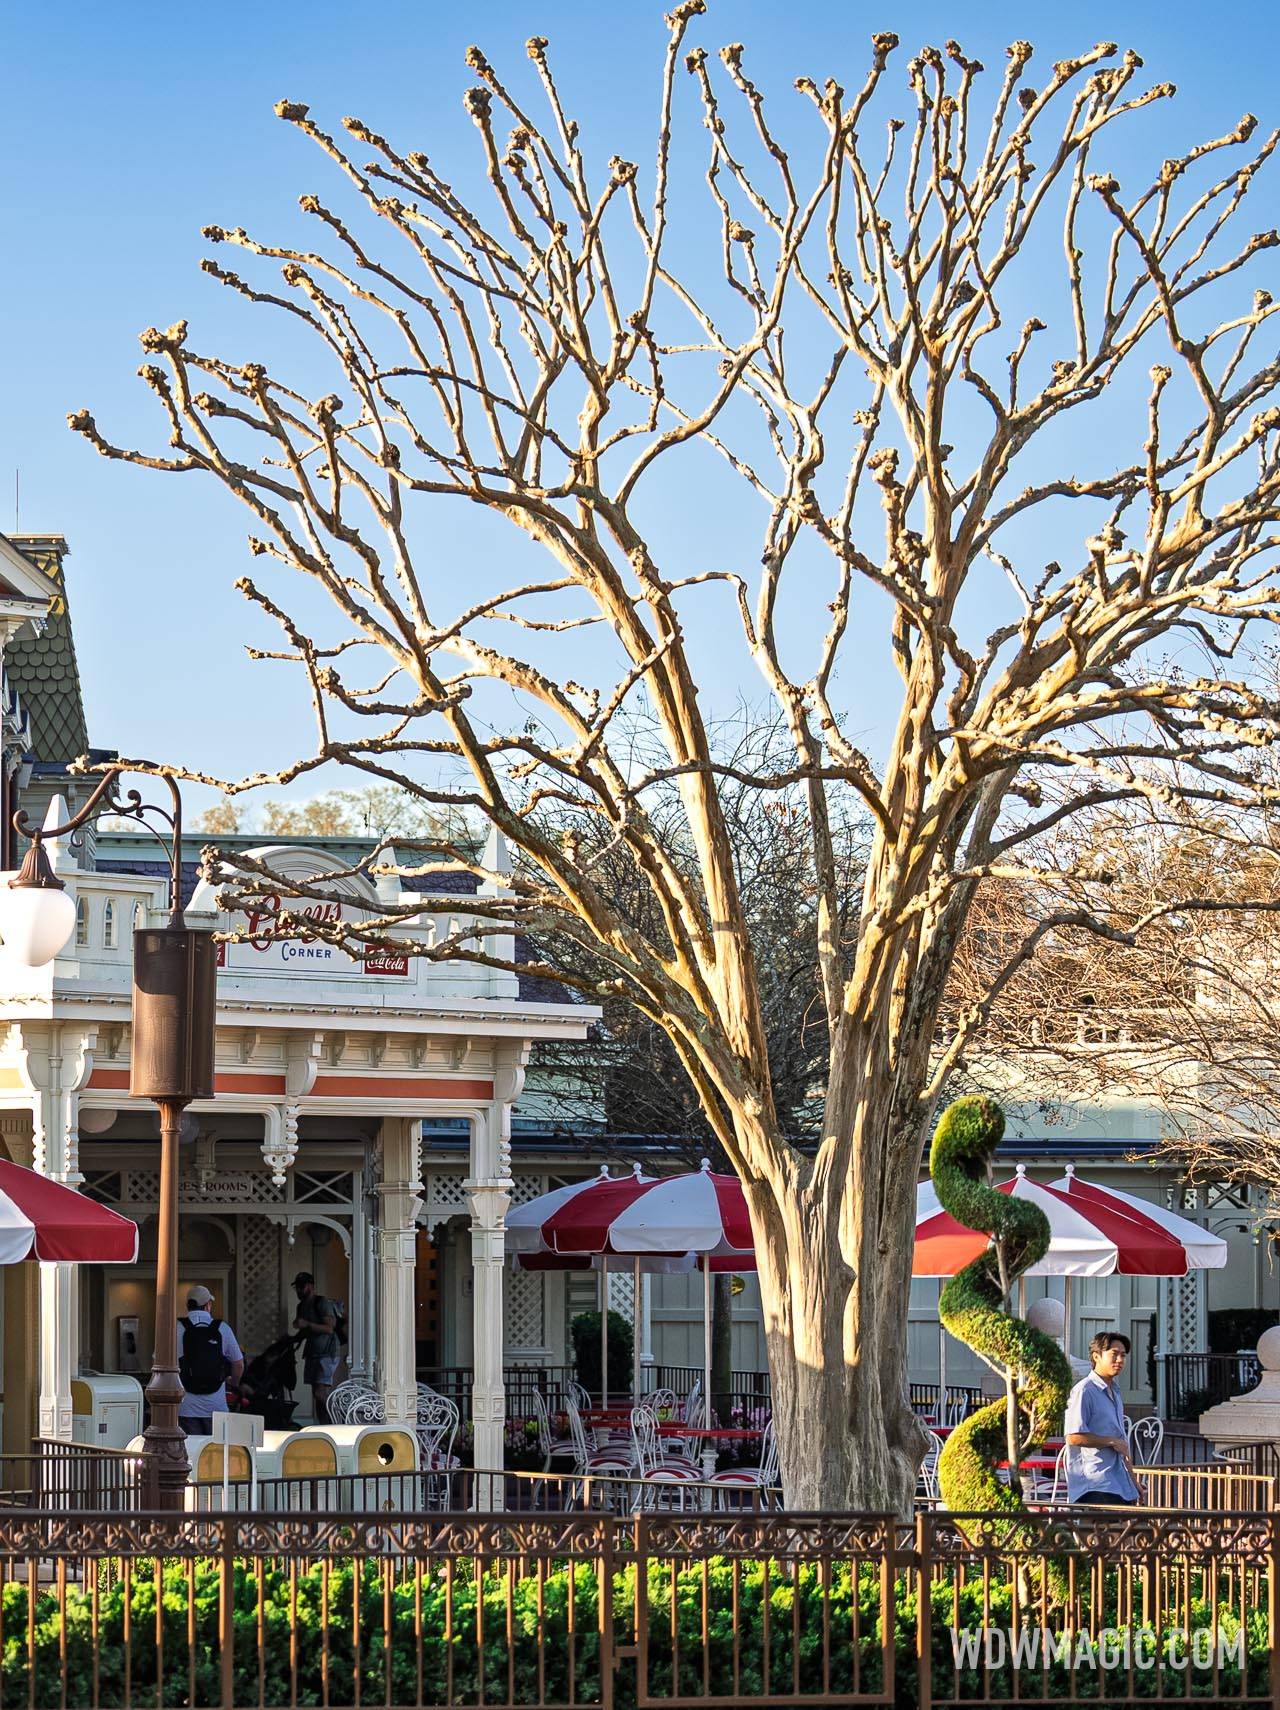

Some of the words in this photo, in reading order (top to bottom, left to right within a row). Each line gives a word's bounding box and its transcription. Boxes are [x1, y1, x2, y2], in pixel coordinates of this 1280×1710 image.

[281, 942, 332, 961] CORNER
[366, 955, 405, 970] CocaCola
[179, 1181, 248, 1192] RESROOMS
